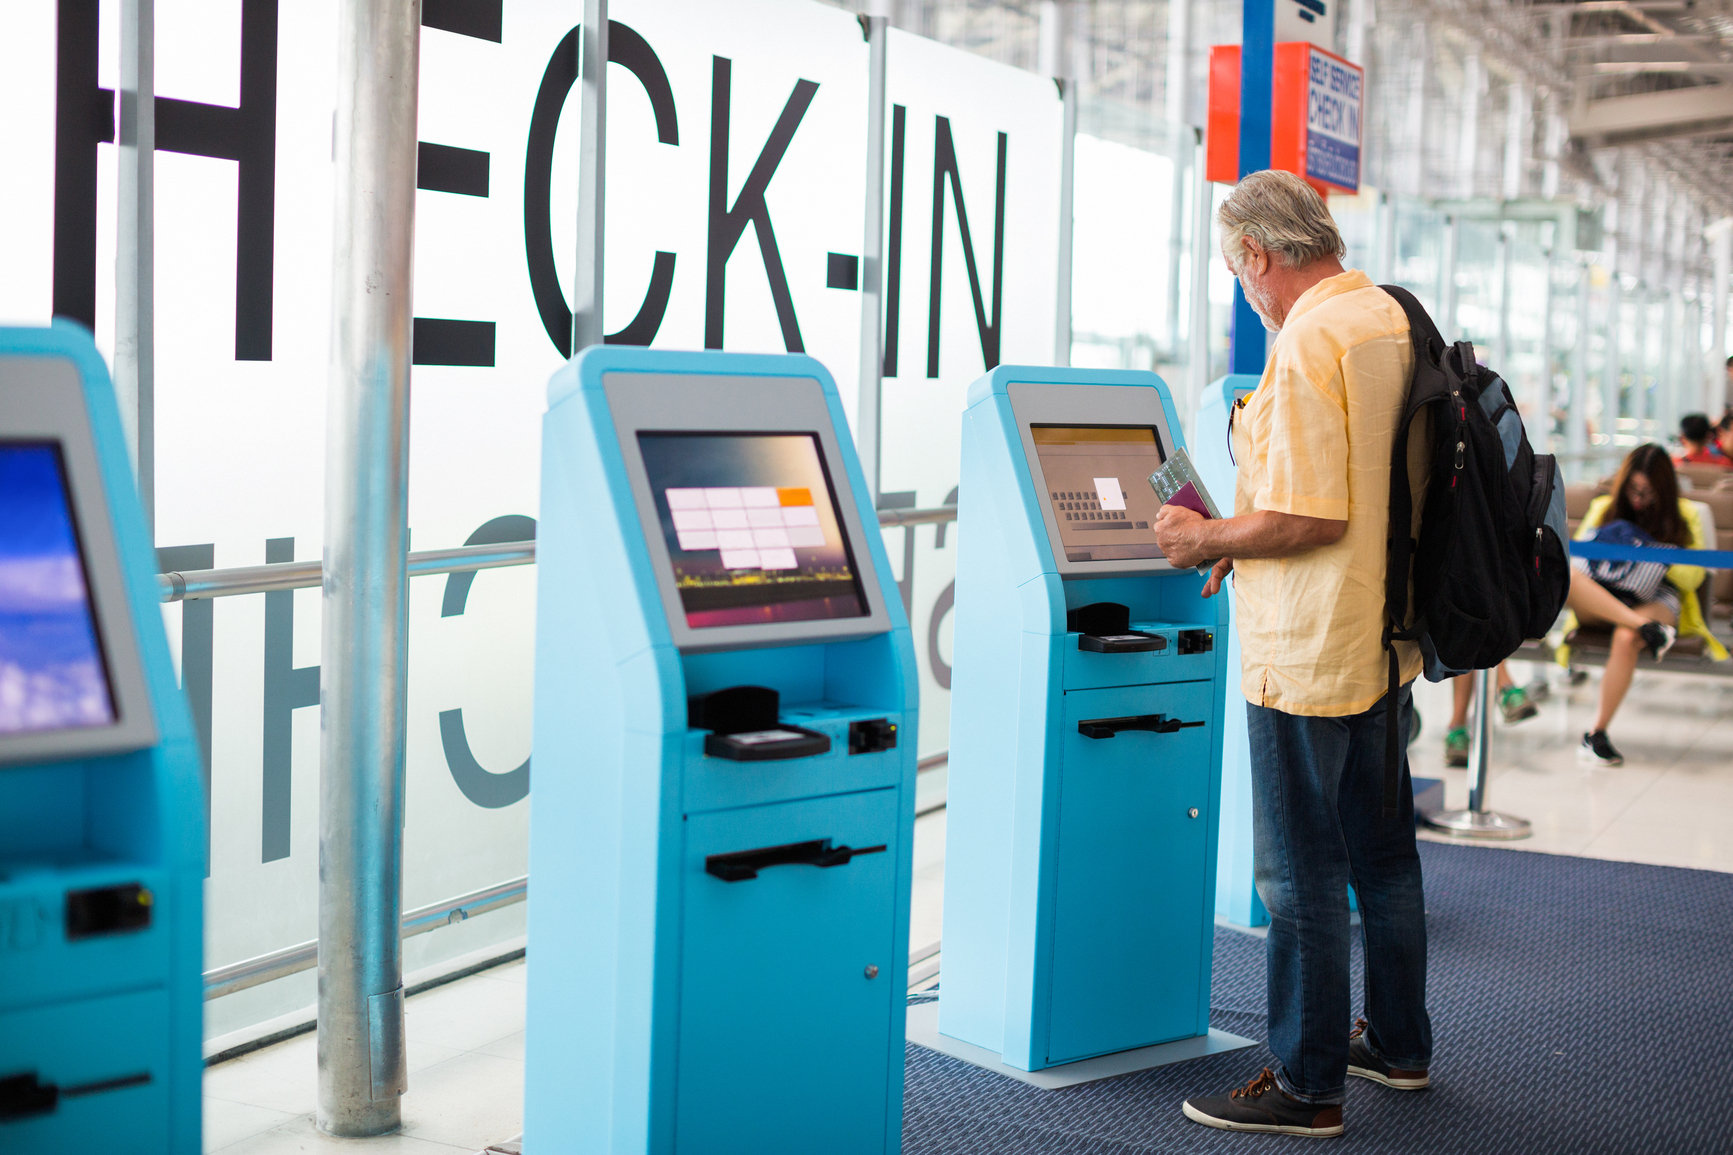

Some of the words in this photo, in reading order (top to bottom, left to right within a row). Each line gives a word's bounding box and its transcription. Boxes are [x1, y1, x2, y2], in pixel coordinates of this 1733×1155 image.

[1310, 56, 1328, 86] SELF
[1331, 65, 1360, 100] SERVICE
[1309, 88, 1347, 135] CHECK
[1349, 103, 1359, 140] IN
